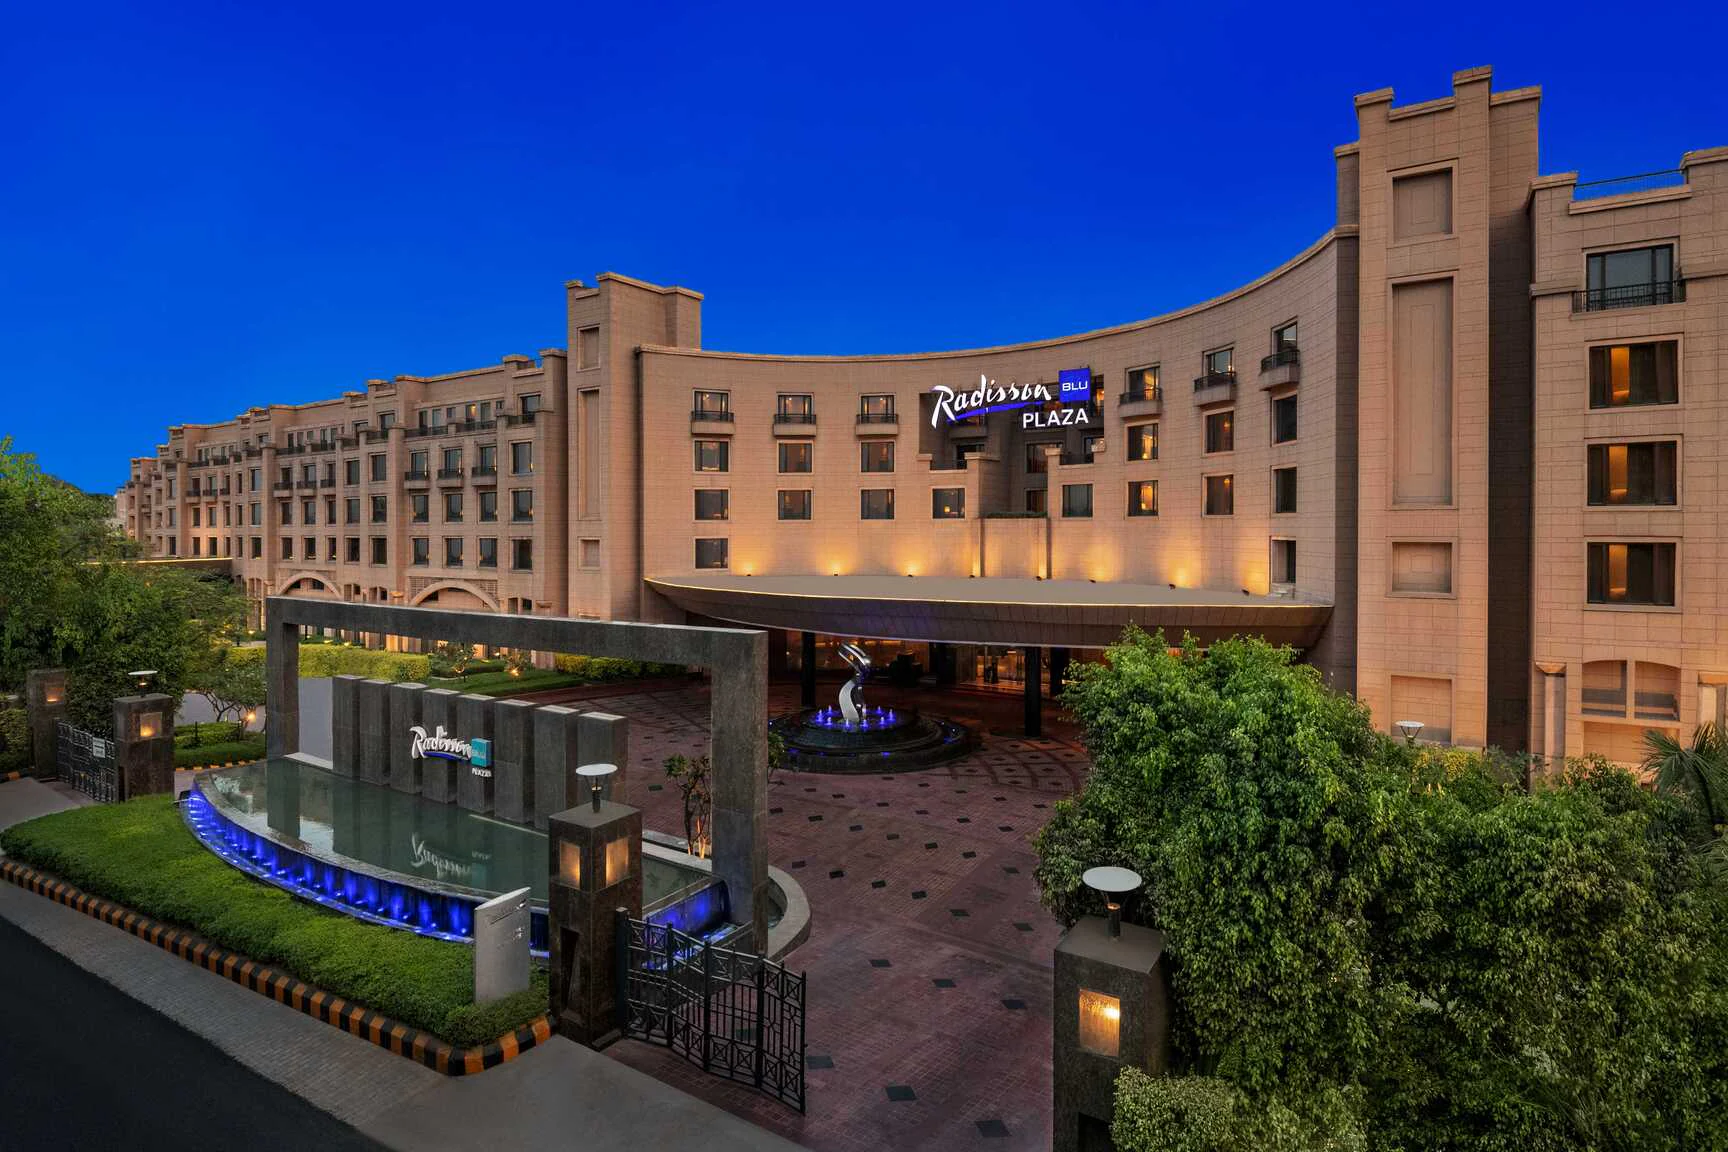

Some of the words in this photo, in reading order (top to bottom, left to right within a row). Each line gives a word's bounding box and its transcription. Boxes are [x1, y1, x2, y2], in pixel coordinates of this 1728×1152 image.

[930, 374, 1051, 429] Radisson
[1062, 380, 1088, 392] BLU
[1023, 408, 1089, 429] PLAZA
[409, 725, 472, 759] Radisson
